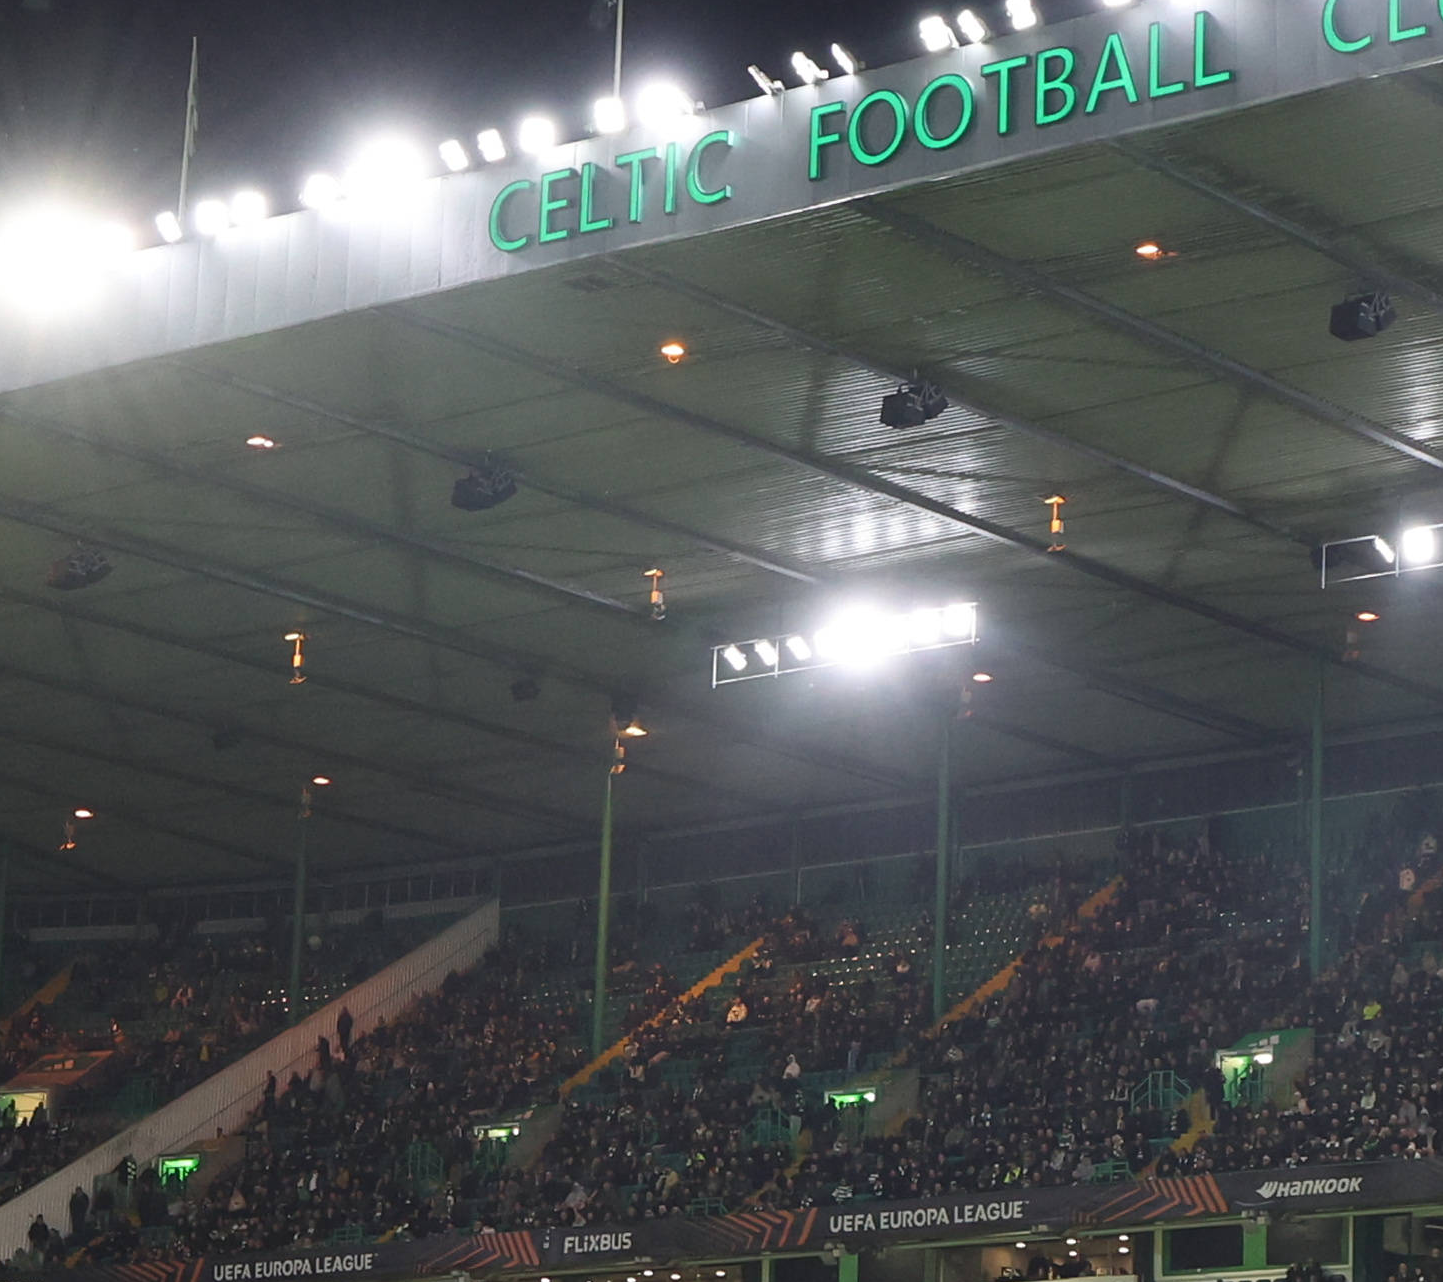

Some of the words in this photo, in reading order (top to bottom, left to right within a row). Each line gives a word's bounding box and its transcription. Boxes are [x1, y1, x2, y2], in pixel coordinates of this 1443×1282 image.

[489, 129, 734, 252] CELTIC
[809, 10, 1232, 181] FOOTBALL
[829, 1213, 875, 1233] UEFA
[879, 1208, 949, 1230] EUROPA
[213, 1262, 252, 1282] UEFA
[254, 1258, 312, 1278] EUROPA
